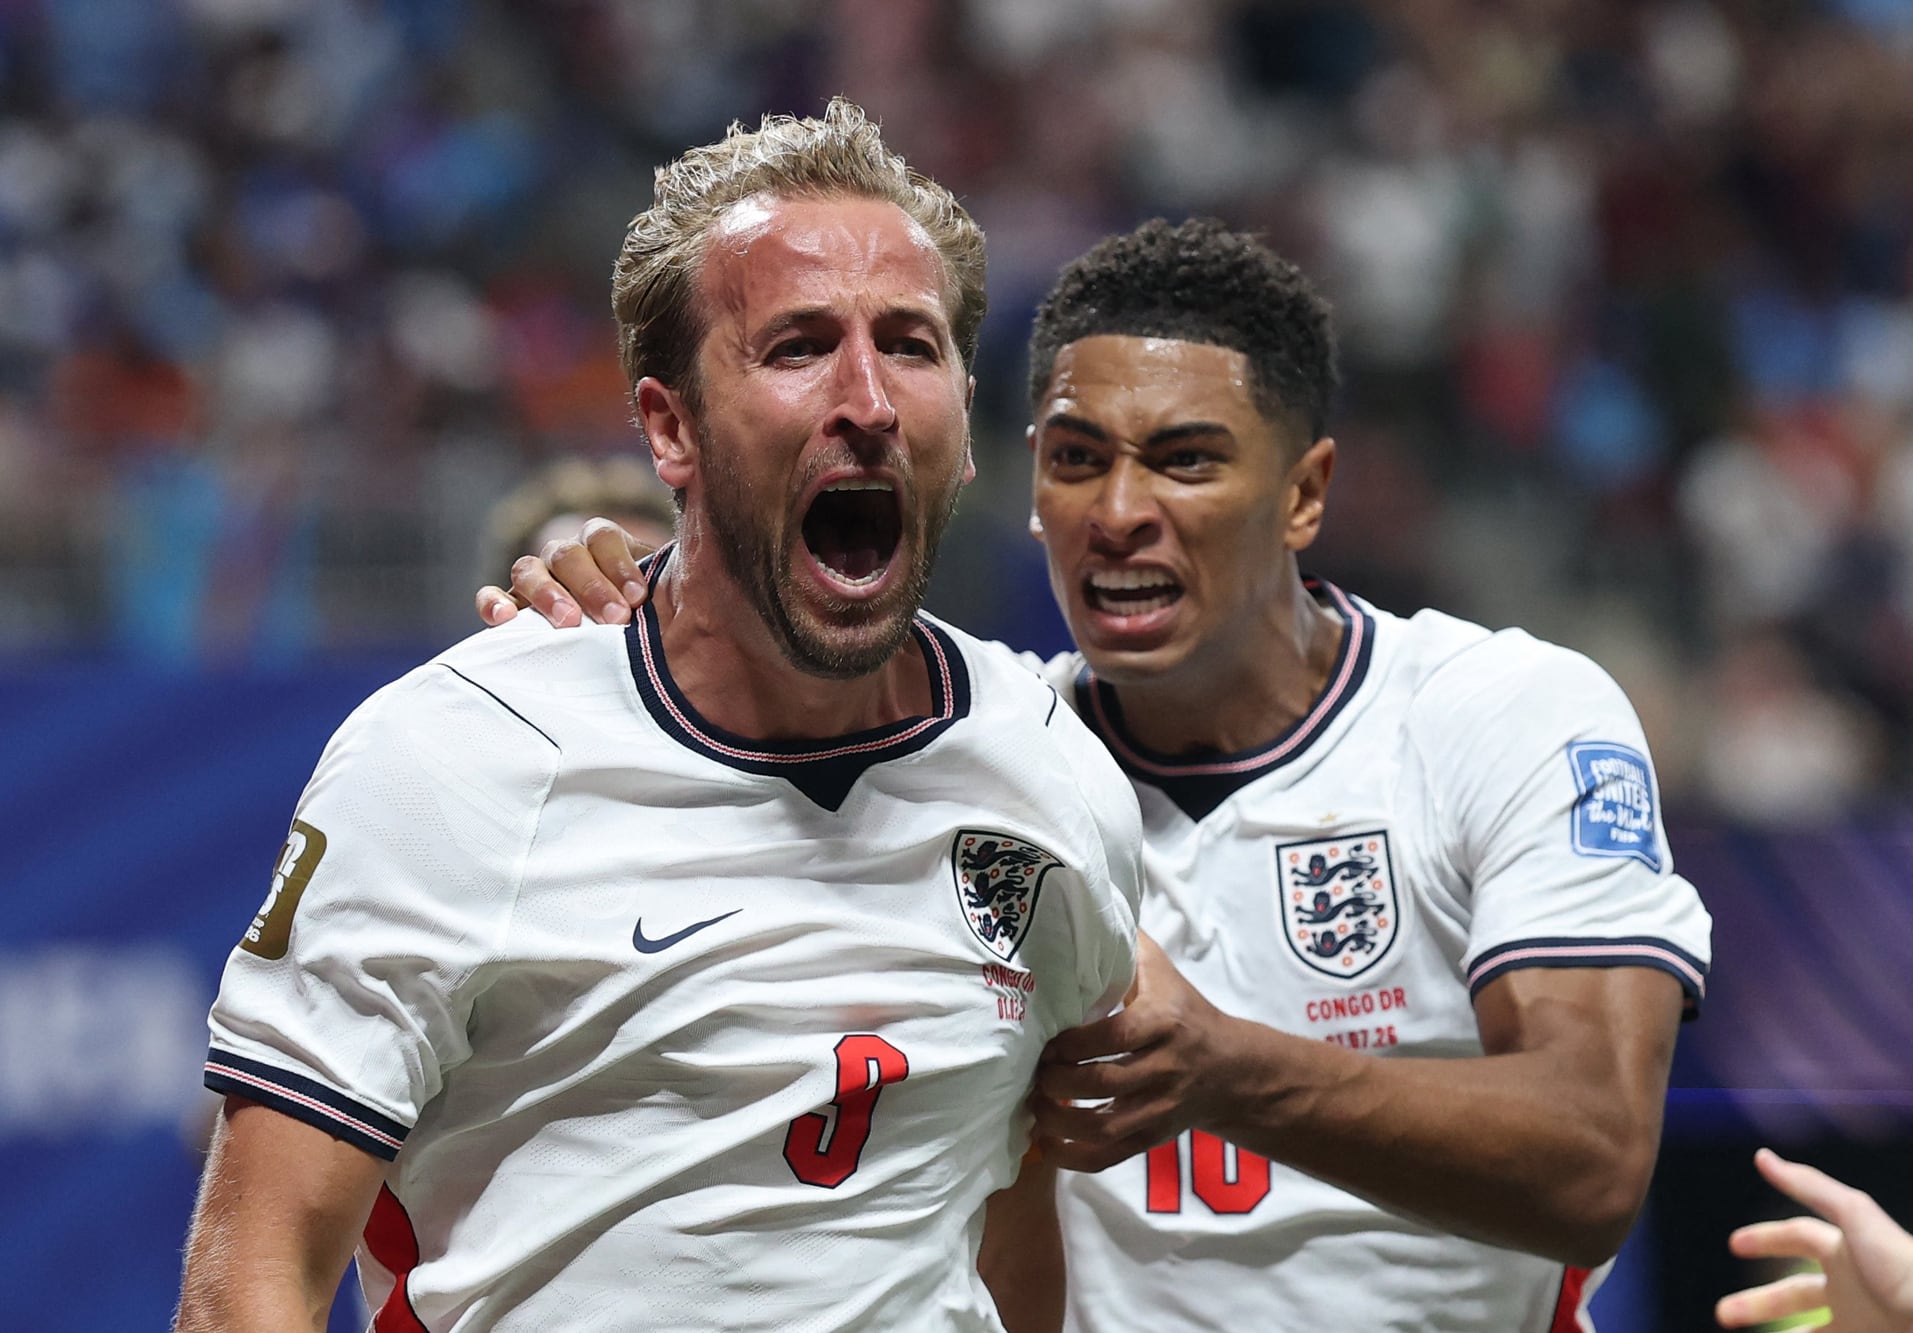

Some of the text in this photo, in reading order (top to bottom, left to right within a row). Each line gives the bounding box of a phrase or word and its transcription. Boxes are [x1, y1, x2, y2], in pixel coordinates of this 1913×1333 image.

[1593, 780, 1651, 813] UNITES
[982, 963, 1021, 989] CONGO
[1306, 986, 1407, 1022] CONGO DR
[782, 1034, 909, 1190] 9
[1146, 1128, 1271, 1215] 10
